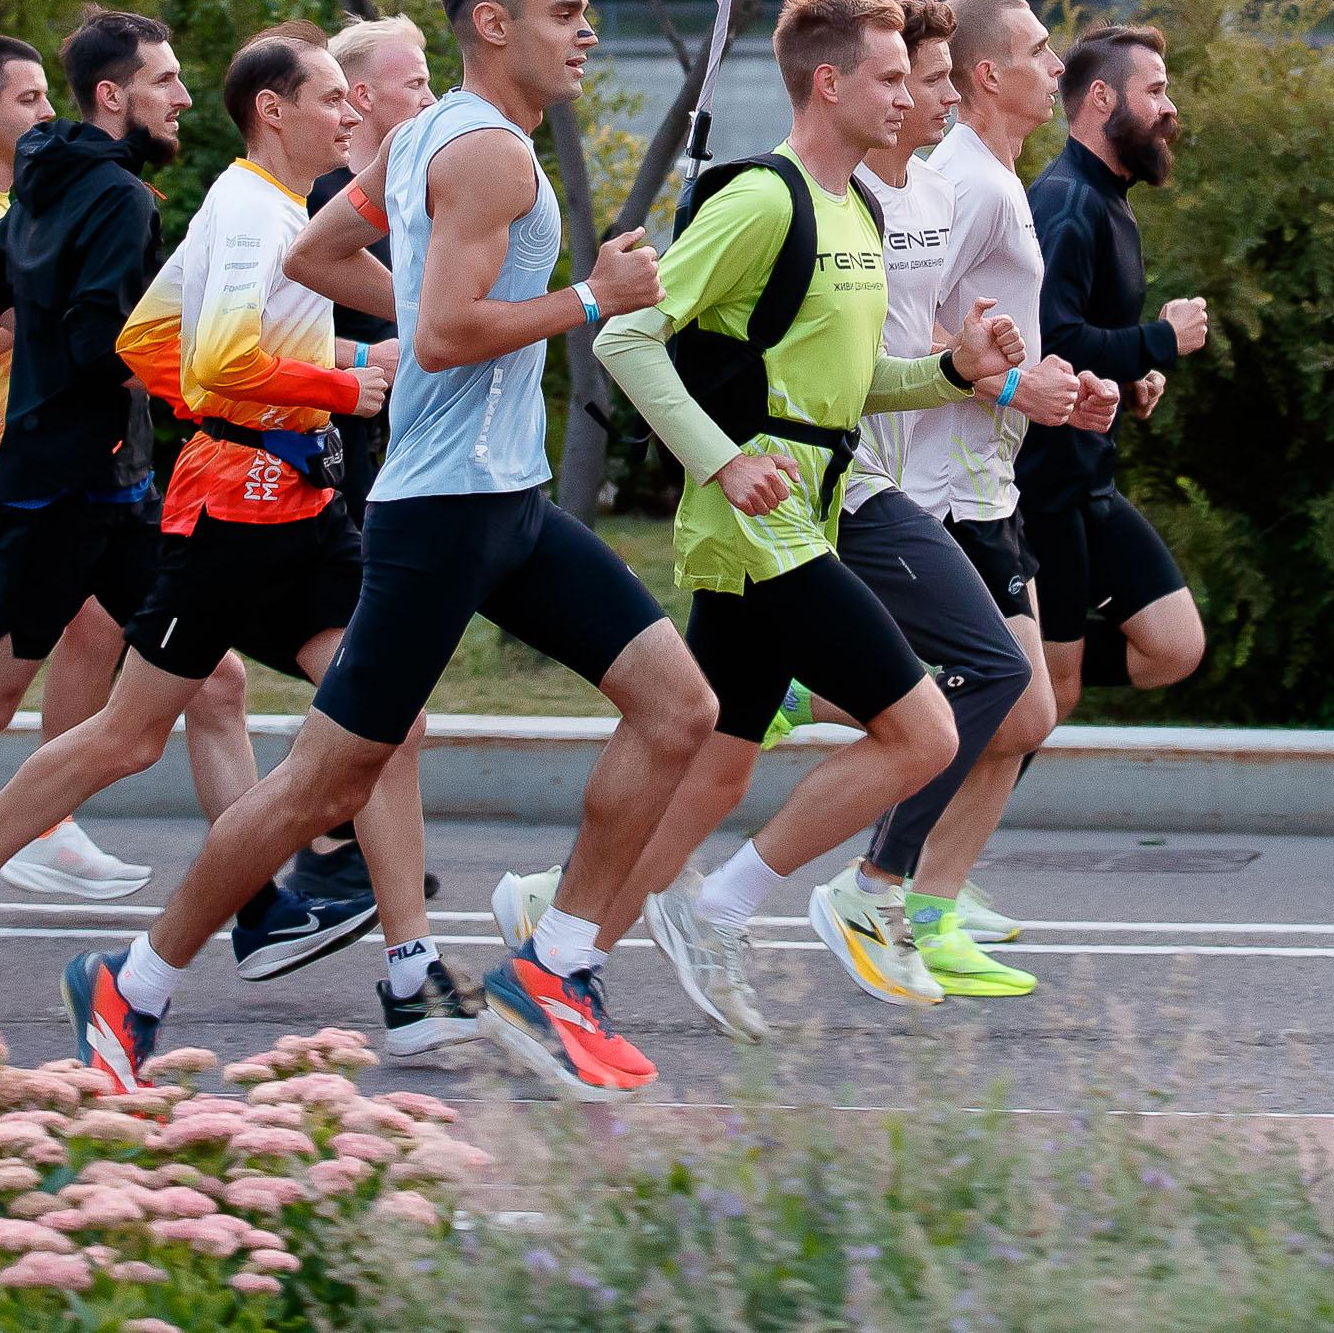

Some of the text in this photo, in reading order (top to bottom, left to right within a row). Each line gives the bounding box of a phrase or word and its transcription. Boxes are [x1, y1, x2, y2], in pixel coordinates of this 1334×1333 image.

[885, 227, 950, 250] ENET
[816, 252, 885, 272] TENET
[888, 261, 909, 271] ЖИВИ
[387, 940, 427, 963] FILA
